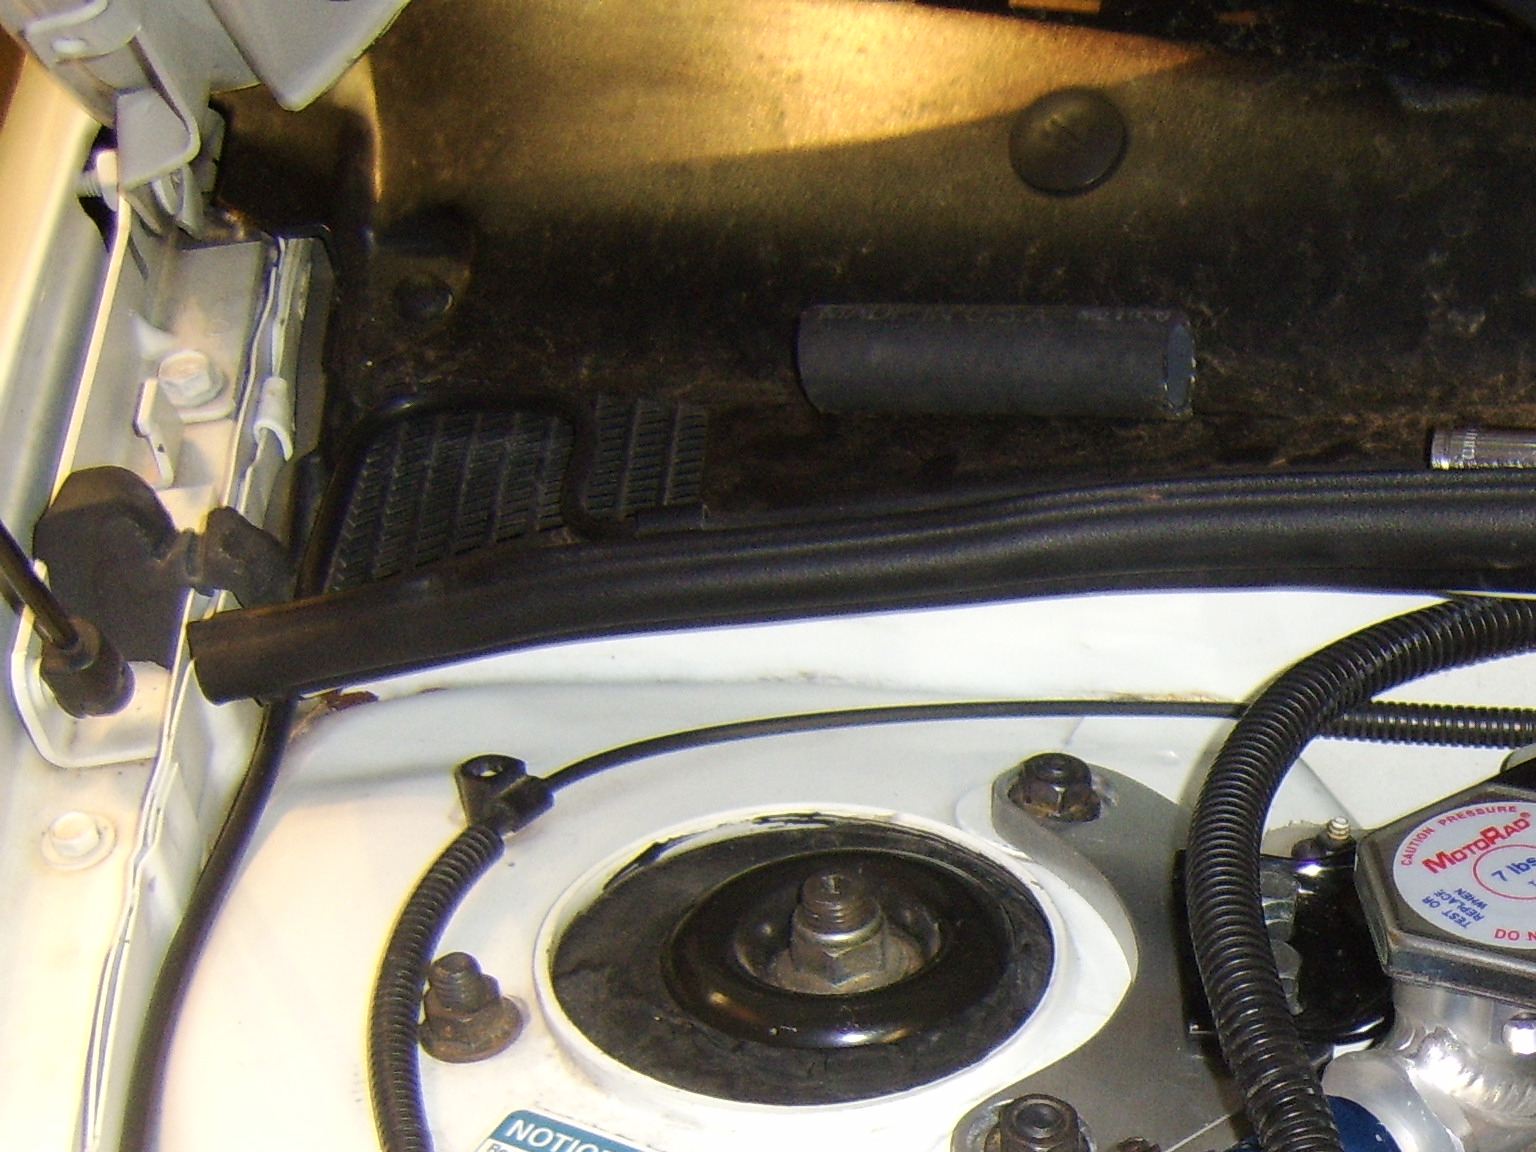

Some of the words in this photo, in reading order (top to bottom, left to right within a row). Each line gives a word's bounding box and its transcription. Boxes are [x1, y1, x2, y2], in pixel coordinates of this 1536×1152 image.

[1401, 827, 1435, 865] CAUTION
[1438, 806, 1517, 825] PRESSURE
[1491, 870, 1507, 881] 7
[1422, 896, 1440, 908] OR
[1454, 888, 1488, 909] WHEN
[1442, 910, 1471, 929] TEST
[1495, 929, 1520, 941] DO
